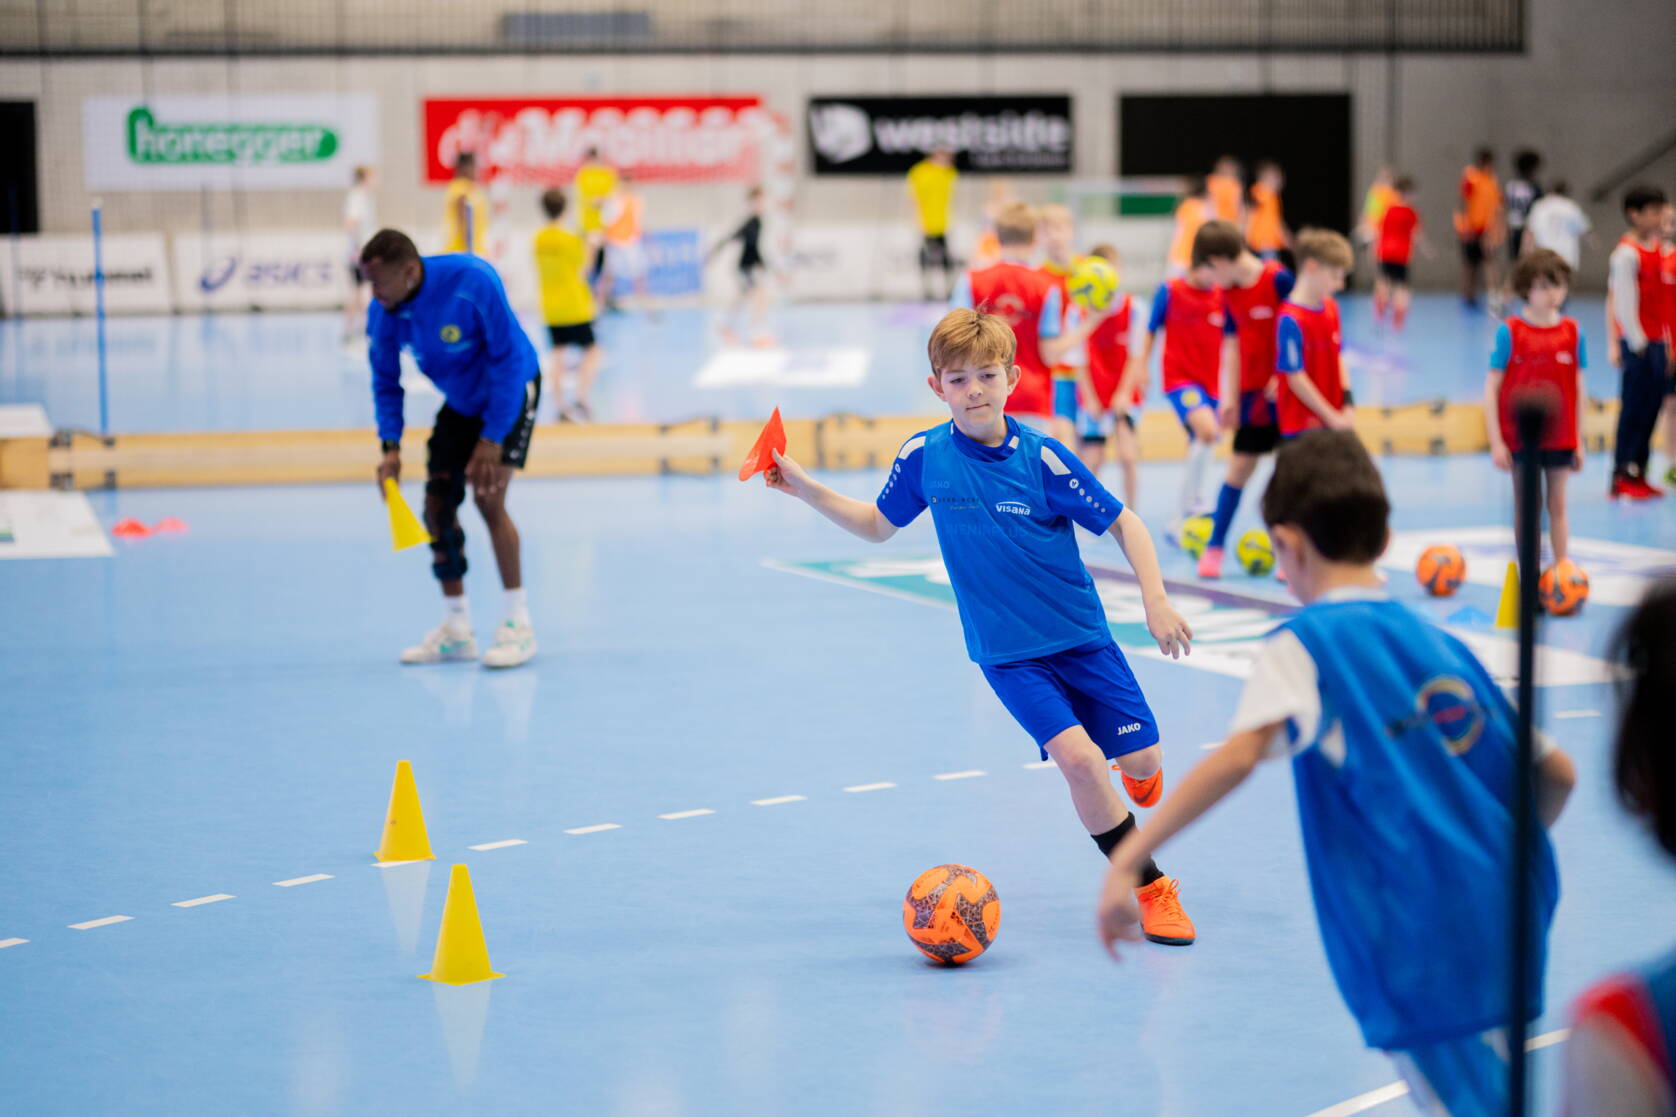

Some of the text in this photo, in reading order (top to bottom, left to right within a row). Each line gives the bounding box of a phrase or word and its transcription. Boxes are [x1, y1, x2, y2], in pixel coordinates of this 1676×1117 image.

[127, 107, 334, 165] honegger
[874, 109, 1070, 153] westside
[1117, 722, 1141, 736] JAKO
